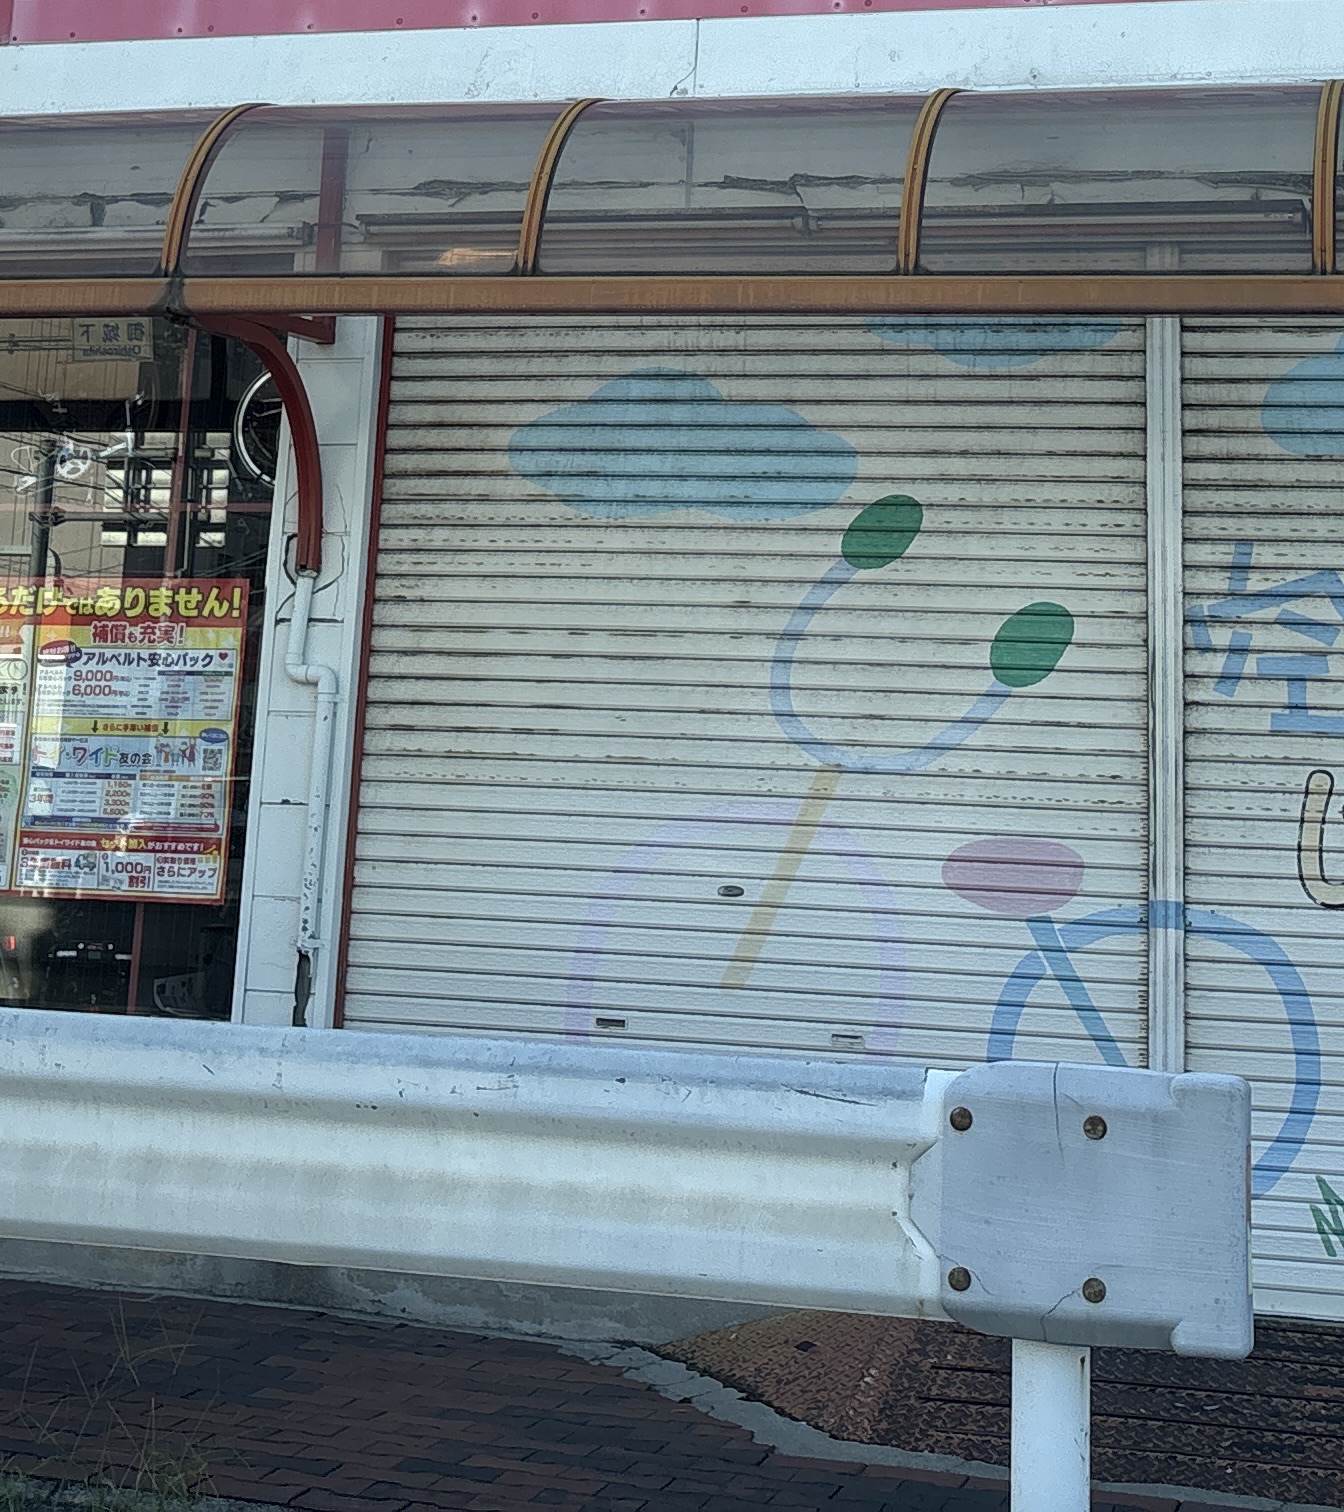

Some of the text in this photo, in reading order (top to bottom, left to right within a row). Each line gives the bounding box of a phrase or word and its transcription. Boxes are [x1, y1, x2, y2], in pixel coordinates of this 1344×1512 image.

[91, 622, 185, 645] 補償も充実!
[82, 651, 214, 668] アルベルト安心パック
[103, 861, 152, 875] 1,000円
[156, 866, 218, 879] さらにアップ
